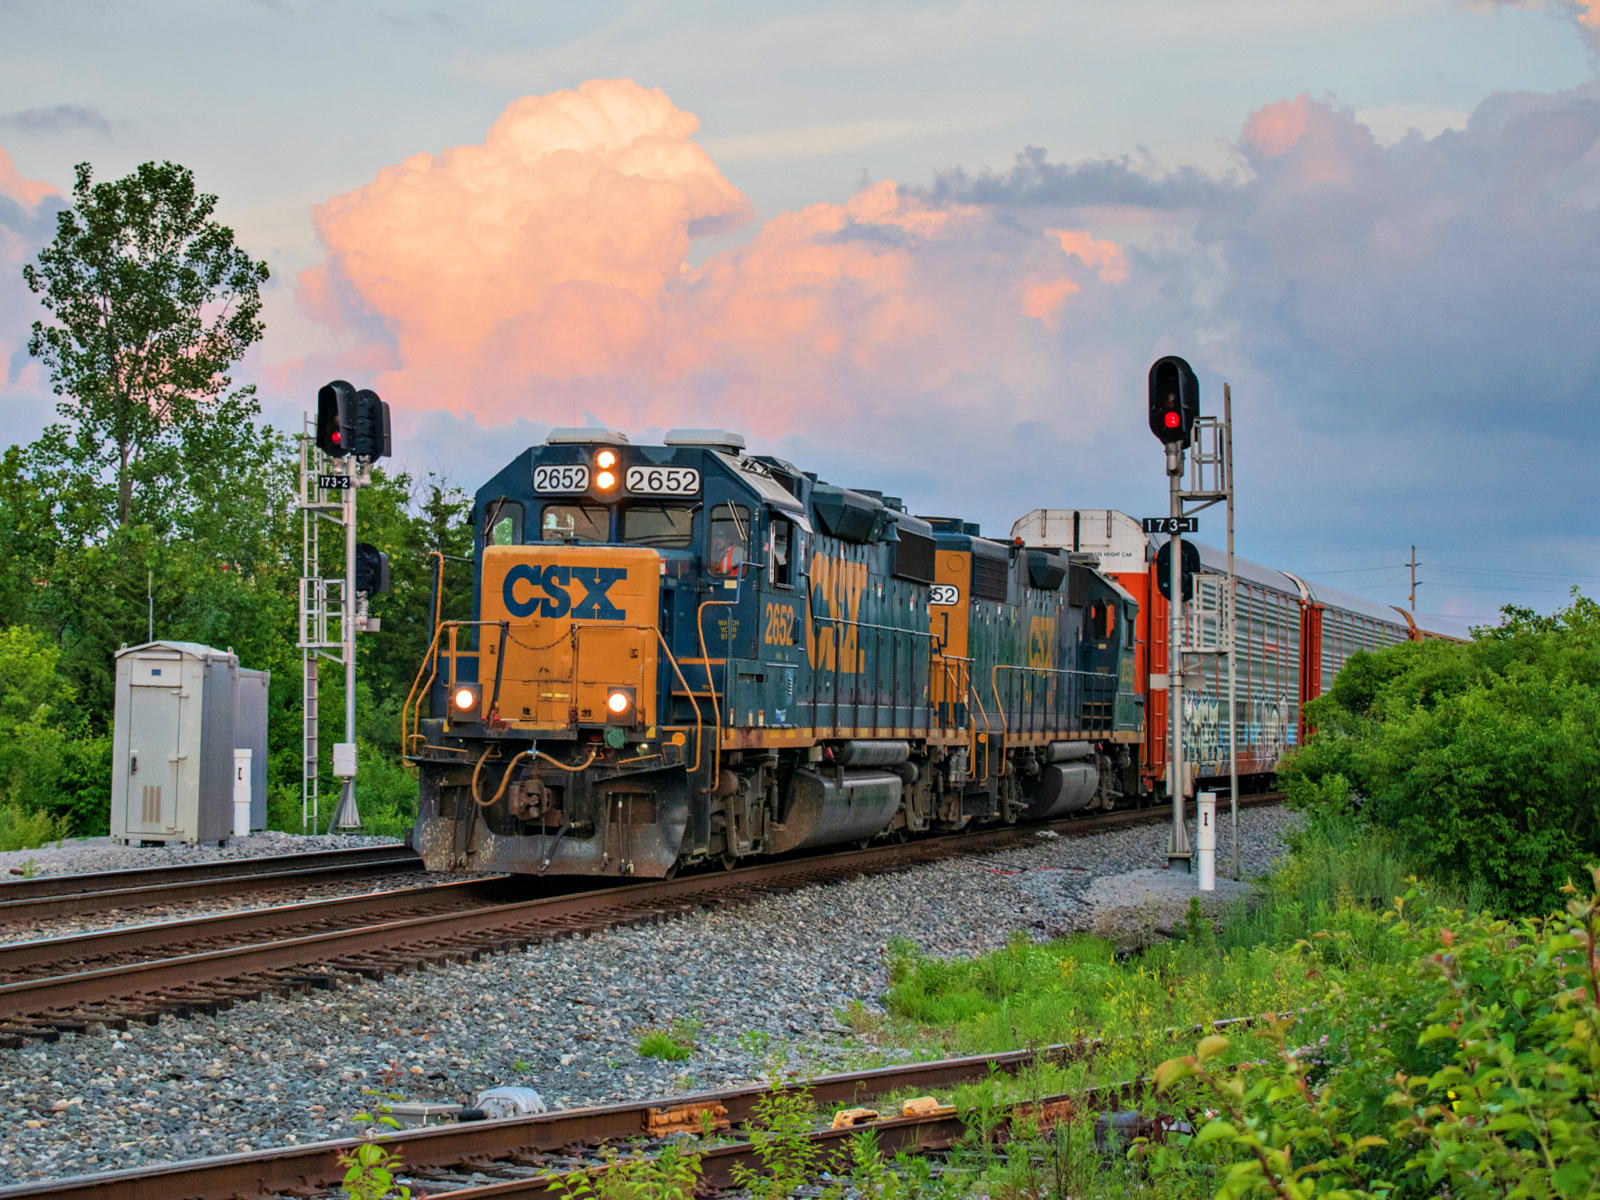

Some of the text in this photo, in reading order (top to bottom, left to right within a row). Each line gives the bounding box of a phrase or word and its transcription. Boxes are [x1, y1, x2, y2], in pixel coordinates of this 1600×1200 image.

[321, 476, 348, 488] 173-2
[536, 468, 586, 490] 2652
[630, 470, 697, 492] 2652
[1147, 518, 1193, 532] 173-1
[502, 564, 627, 621] CSX
[805, 551, 867, 674] CSX
[765, 602, 793, 646] 2652
